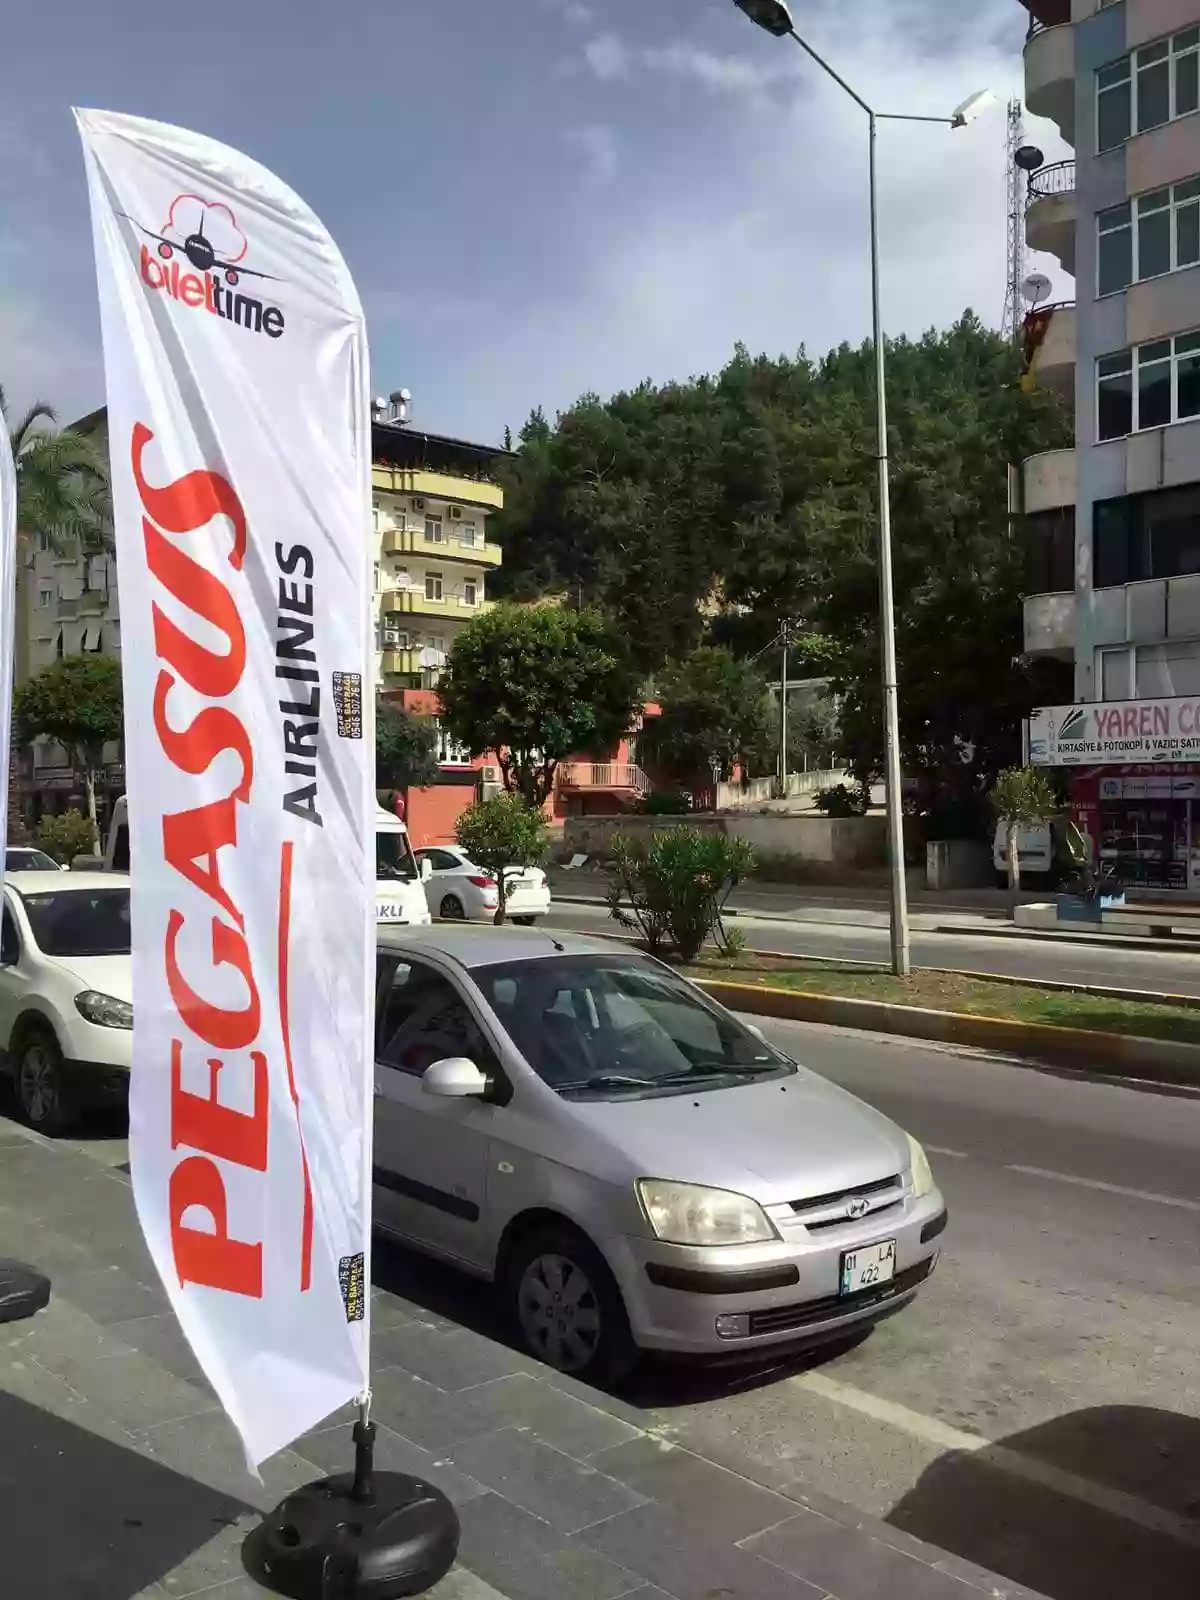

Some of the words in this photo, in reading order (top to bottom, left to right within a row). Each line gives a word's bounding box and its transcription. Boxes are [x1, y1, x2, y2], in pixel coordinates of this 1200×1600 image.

[139, 244, 285, 338] bilettime
[275, 541, 324, 828] AIRLINES
[343, 717, 351, 733] YOL
[351, 717, 360, 737] 0546
[1094, 705, 1169, 738] YAREN
[1057, 739, 1095, 753] KIRTASİYE
[1104, 737, 1143, 752] FOTOKOPİ
[1180, 737, 1200, 749] SATI
[131, 421, 269, 1299] PEGASUS
[846, 1254, 856, 1271] 01
[879, 1244, 893, 1262] LA
[860, 1267, 880, 1283] 422
[347, 1301, 356, 1318] YOL
